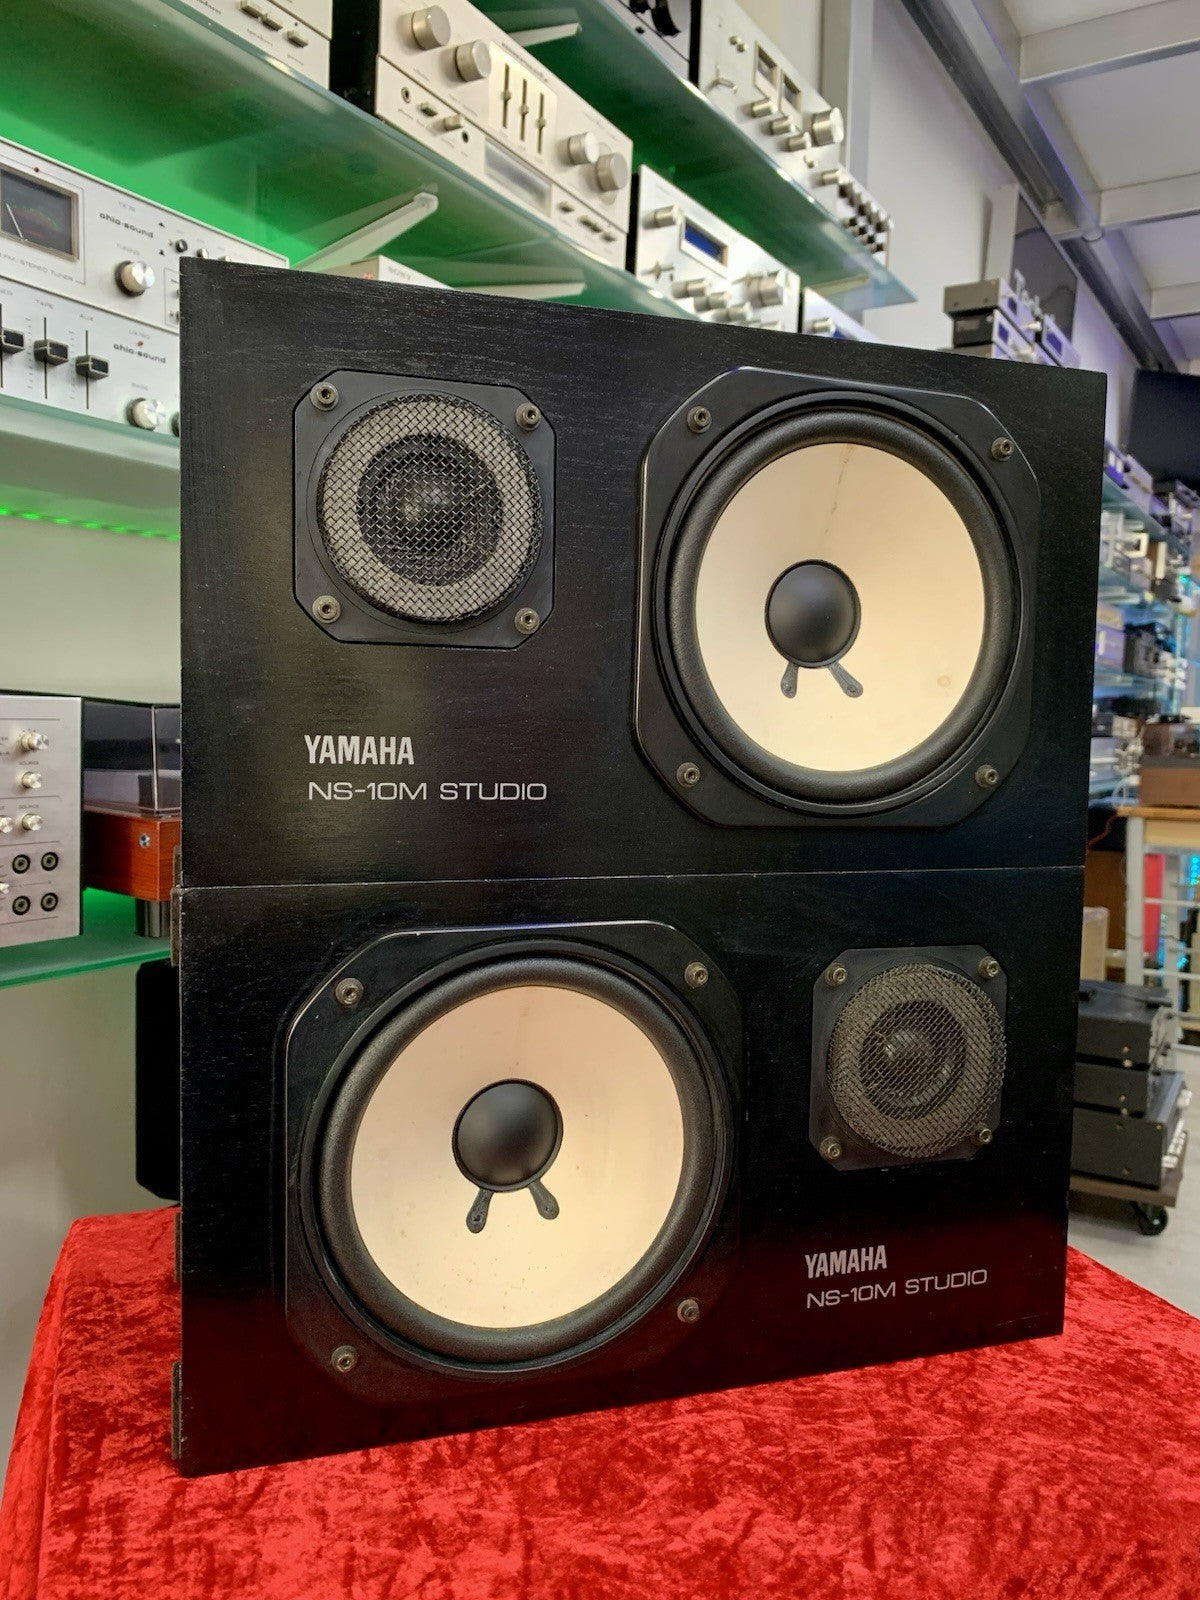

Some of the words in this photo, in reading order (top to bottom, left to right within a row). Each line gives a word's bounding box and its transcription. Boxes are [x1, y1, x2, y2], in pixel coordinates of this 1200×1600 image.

[304, 734, 415, 765] YAMAHA
[308, 782, 428, 801] NS-10M
[439, 782, 548, 801] STUDIO
[804, 1244, 888, 1279] YAMAHA
[806, 1281, 897, 1309] NS-10M
[904, 1268, 988, 1295] STUDIO
